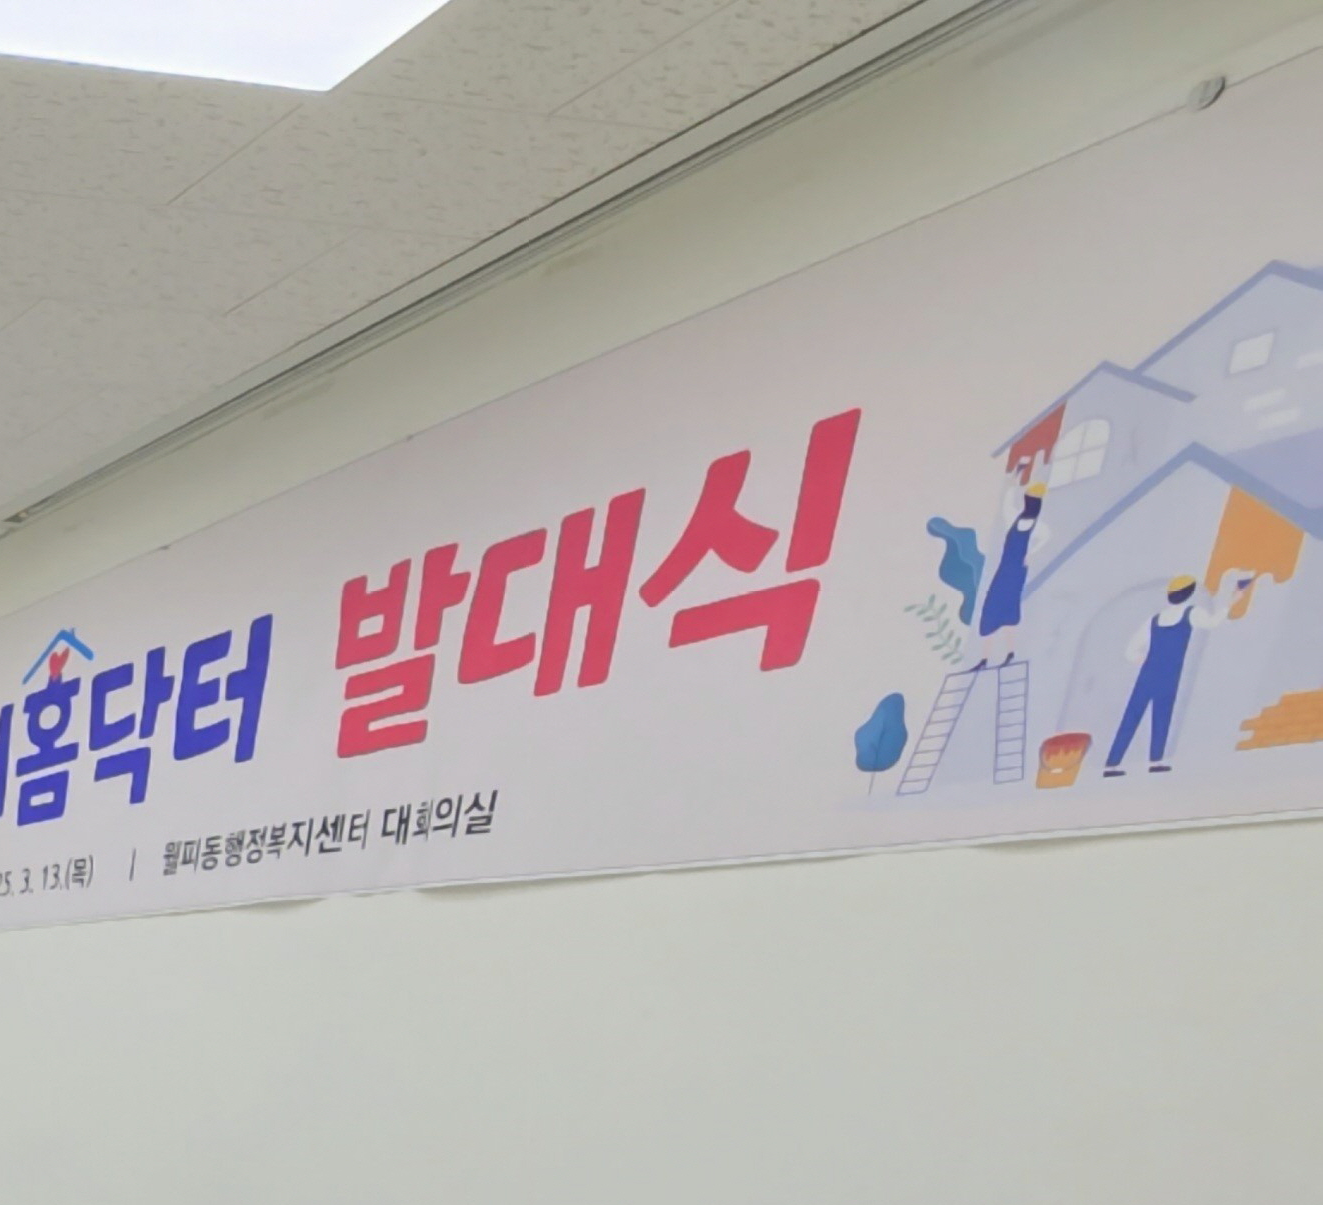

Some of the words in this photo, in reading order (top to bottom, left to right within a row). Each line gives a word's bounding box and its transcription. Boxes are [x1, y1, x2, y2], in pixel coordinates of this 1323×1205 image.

[335, 406, 862, 758] 발대식
[161, 807, 372, 877] 월피동행정복지센터
[379, 787, 499, 847] 대회의실
